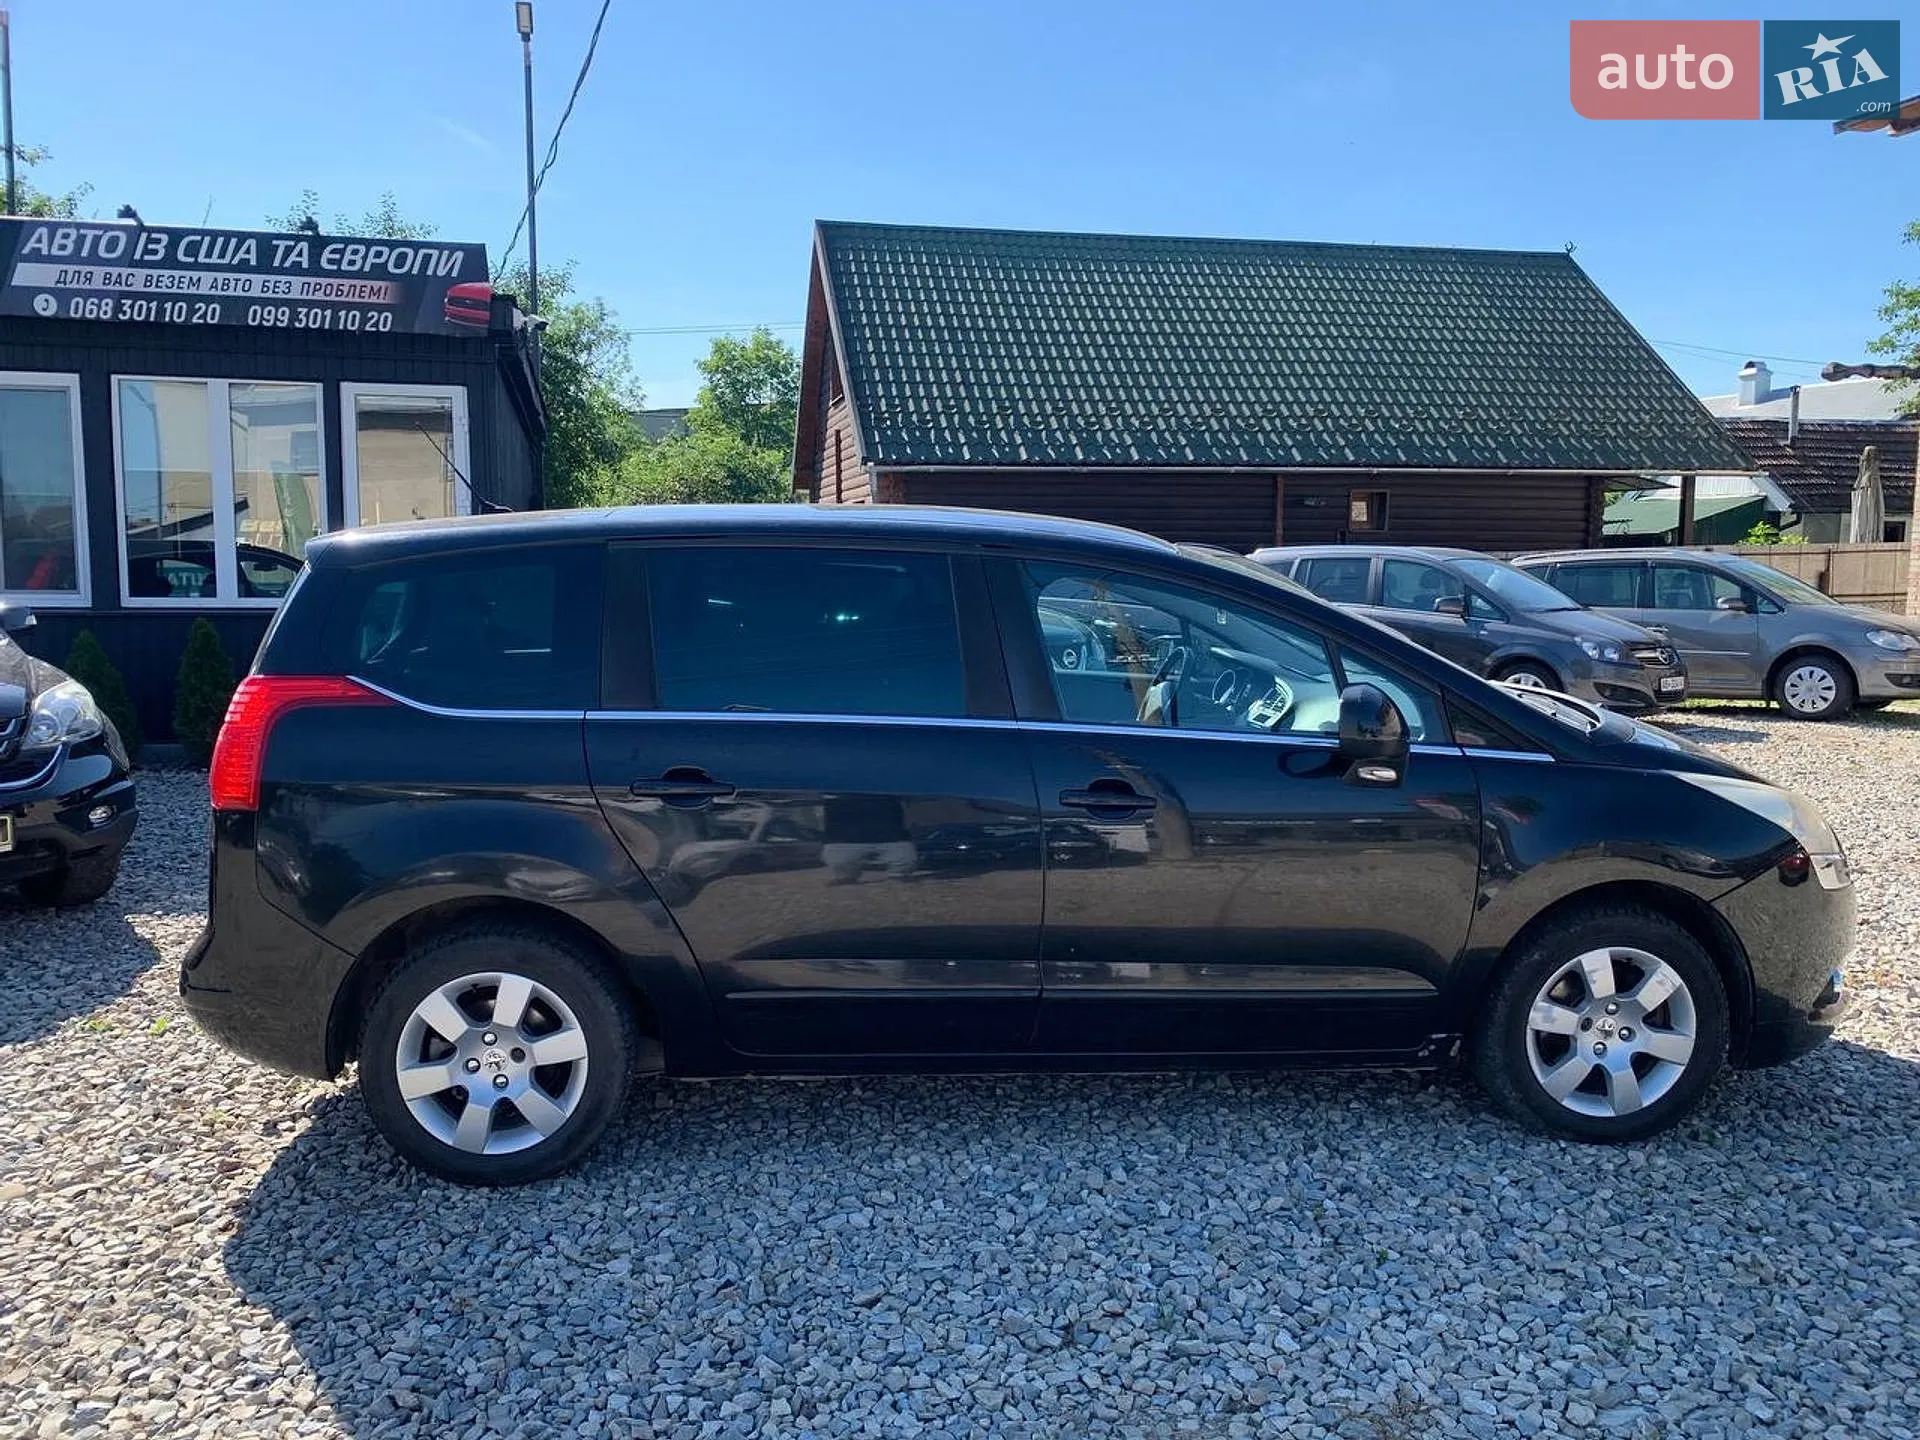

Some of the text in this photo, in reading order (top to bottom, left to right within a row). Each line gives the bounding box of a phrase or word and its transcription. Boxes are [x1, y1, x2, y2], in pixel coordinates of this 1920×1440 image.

[21, 226, 464, 277] АВТО ІЗ США ТА ЄВРОПИ
[55, 269, 389, 300] ДЛЯ ВАС ВЕЗЕМ АВТО БЕЗ ПРОБЛЕМ!
[69, 297, 393, 332] 068 301 10 20 099 301 10 20
